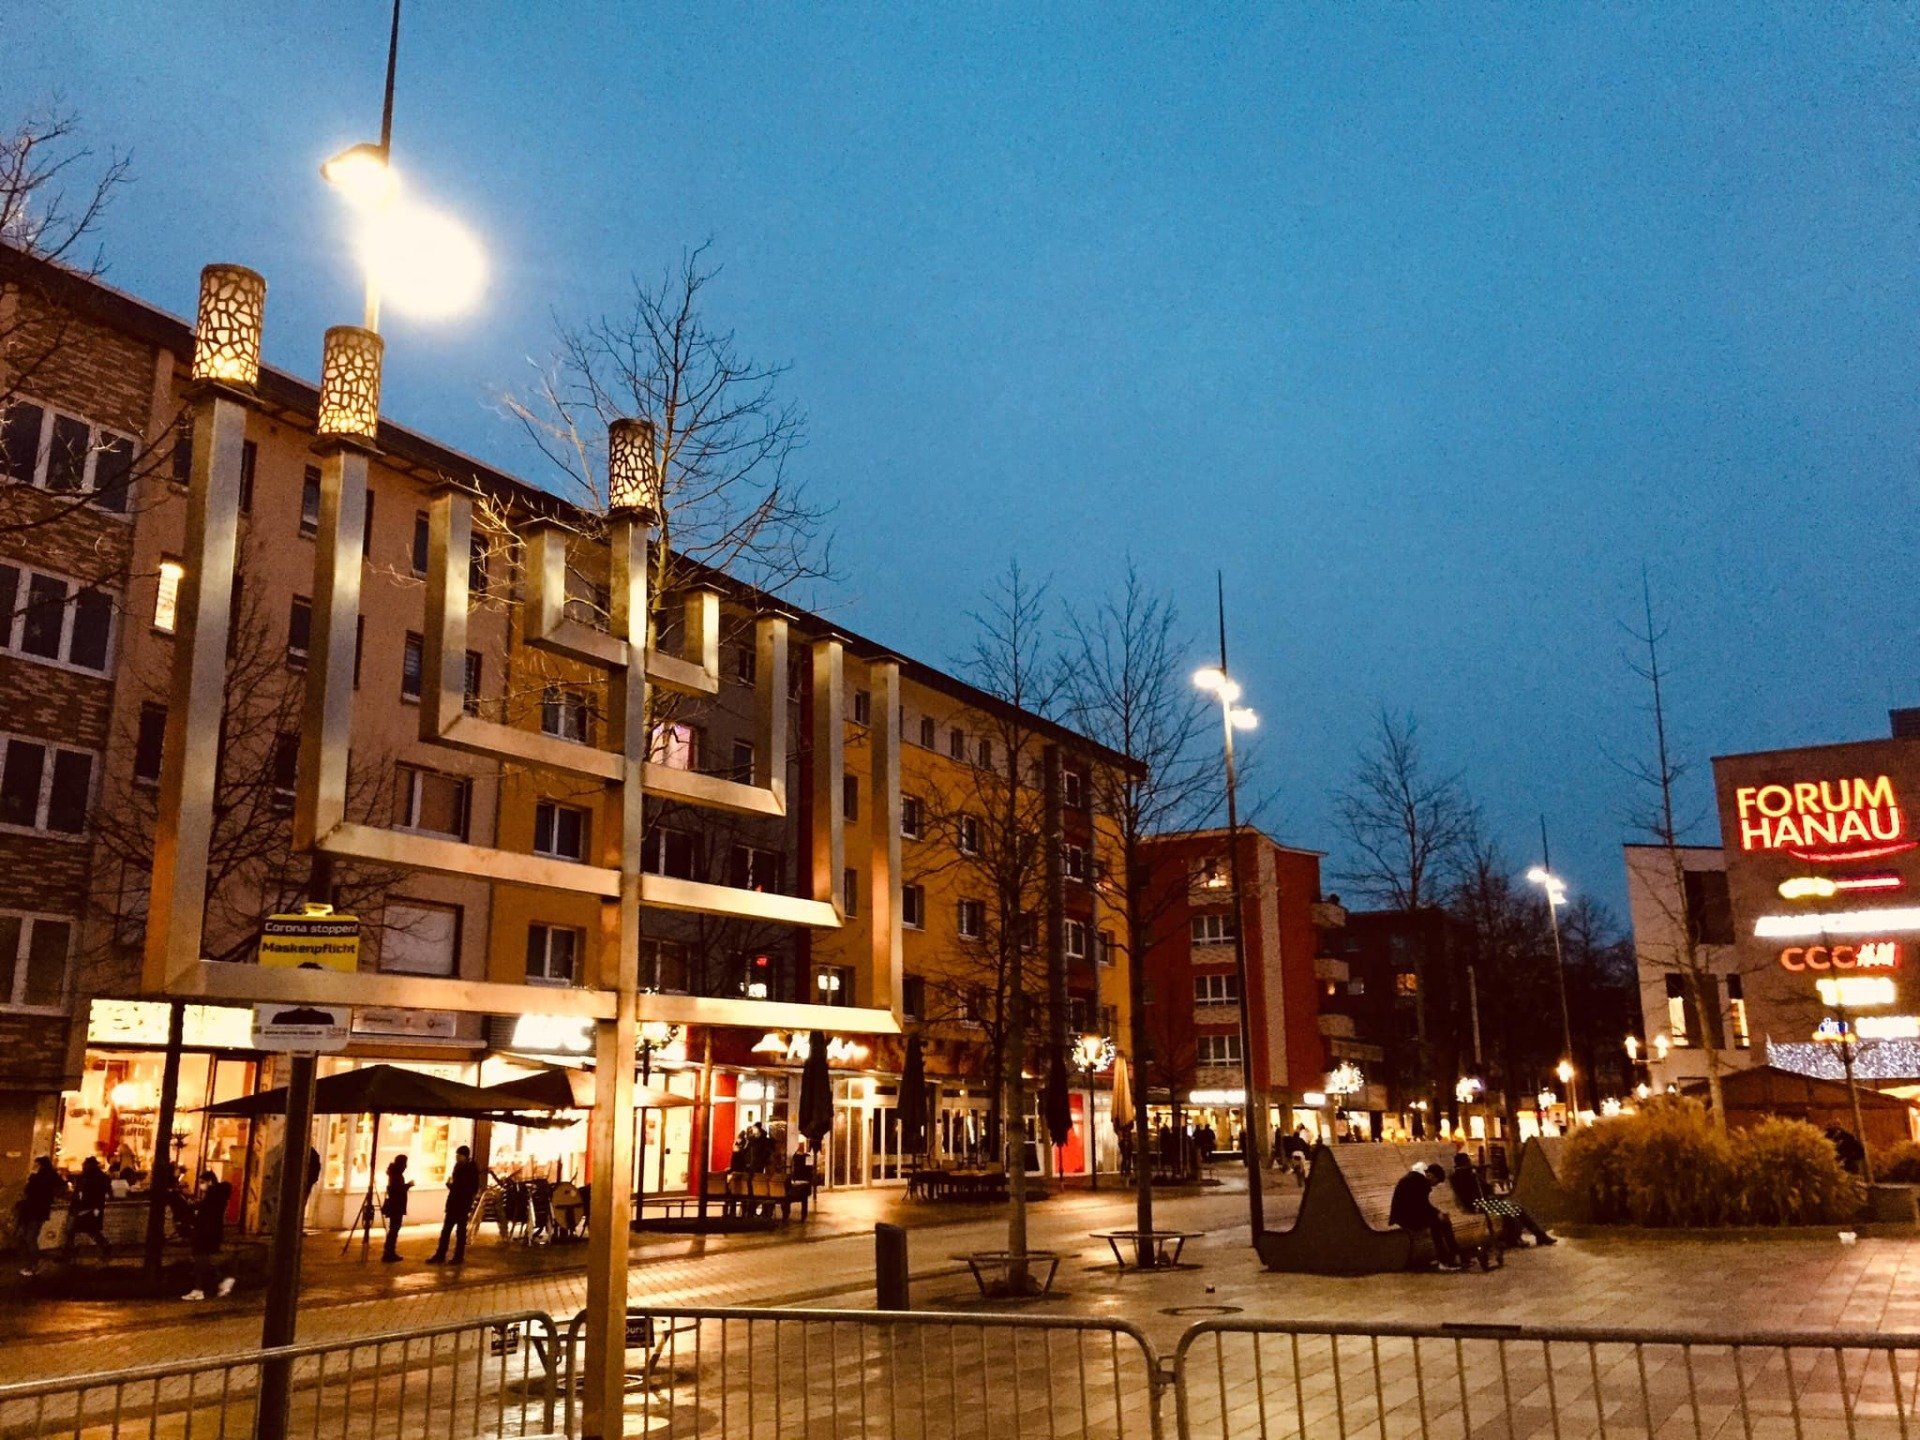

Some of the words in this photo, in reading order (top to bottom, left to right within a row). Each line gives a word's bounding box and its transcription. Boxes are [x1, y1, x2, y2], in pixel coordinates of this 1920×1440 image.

[1737, 775, 1896, 817] FORUM
[1741, 807, 1900, 849] HANAU
[265, 922, 307, 933] Corona
[262, 942, 355, 955] Maskenpflicht
[1781, 945, 1855, 971] CCC
